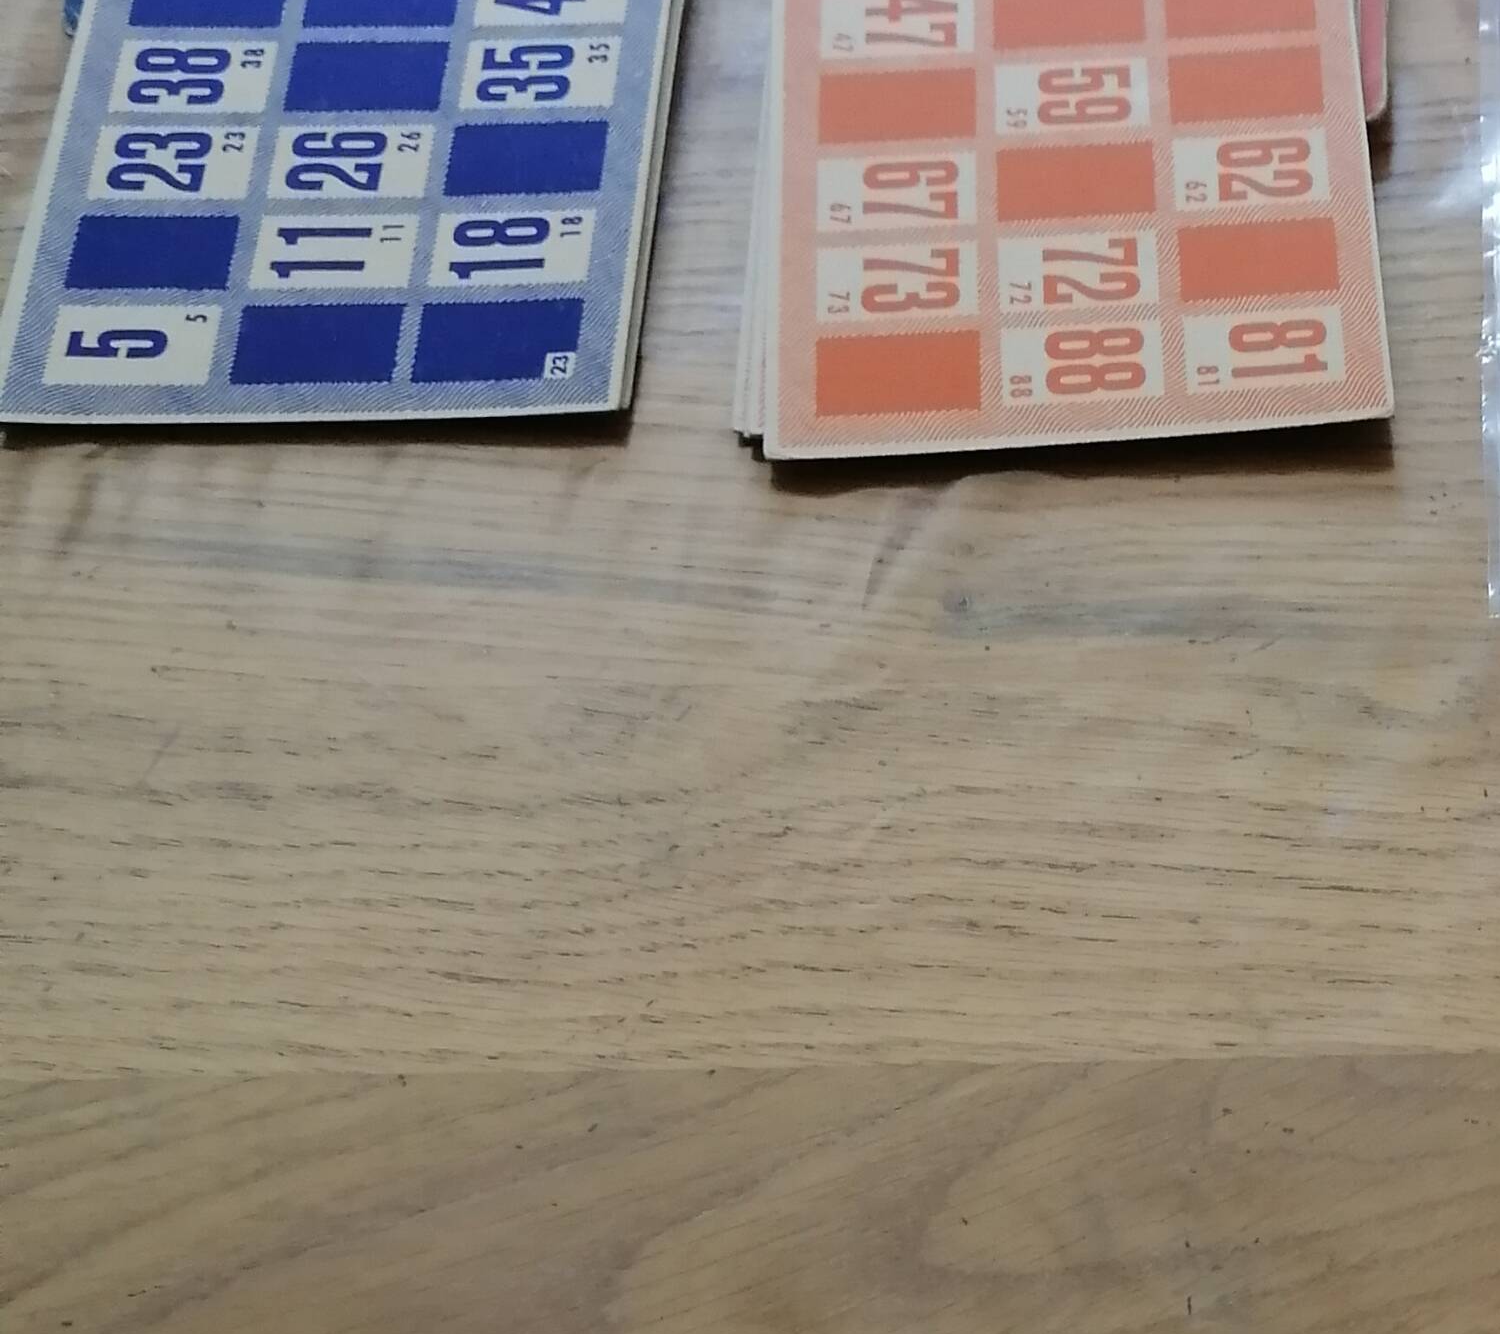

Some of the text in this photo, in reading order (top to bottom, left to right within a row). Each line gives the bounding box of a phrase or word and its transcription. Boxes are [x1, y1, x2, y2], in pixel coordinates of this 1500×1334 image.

[241, 49, 264, 68] 38
[588, 44, 610, 63] 35
[128, 48, 231, 104] 38
[477, 45, 574, 101] 35
[1037, 66, 1131, 125] 59
[1006, 109, 1027, 129] 59
[222, 132, 245, 152] 23
[397, 132, 421, 152] 26
[107, 132, 212, 192] 23
[285, 132, 387, 191] 26
[1217, 138, 1312, 202] 62
[863, 161, 958, 219] 67
[1185, 181, 1207, 203] 62
[830, 203, 852, 224] 67
[380, 225, 404, 243] 11
[560, 217, 582, 237] 18
[270, 228, 372, 278] 11
[449, 217, 550, 279] 18
[861, 248, 960, 313] 73
[1042, 237, 1140, 305] 72
[828, 292, 850, 313] 73
[1008, 280, 1028, 305] 72
[65, 330, 168, 358] 5
[1229, 319, 1328, 379] 81
[550, 356, 568, 374] 23
[1045, 328, 1145, 395] 88
[1009, 375, 1032, 398] 88
[1197, 366, 1220, 385] 81
